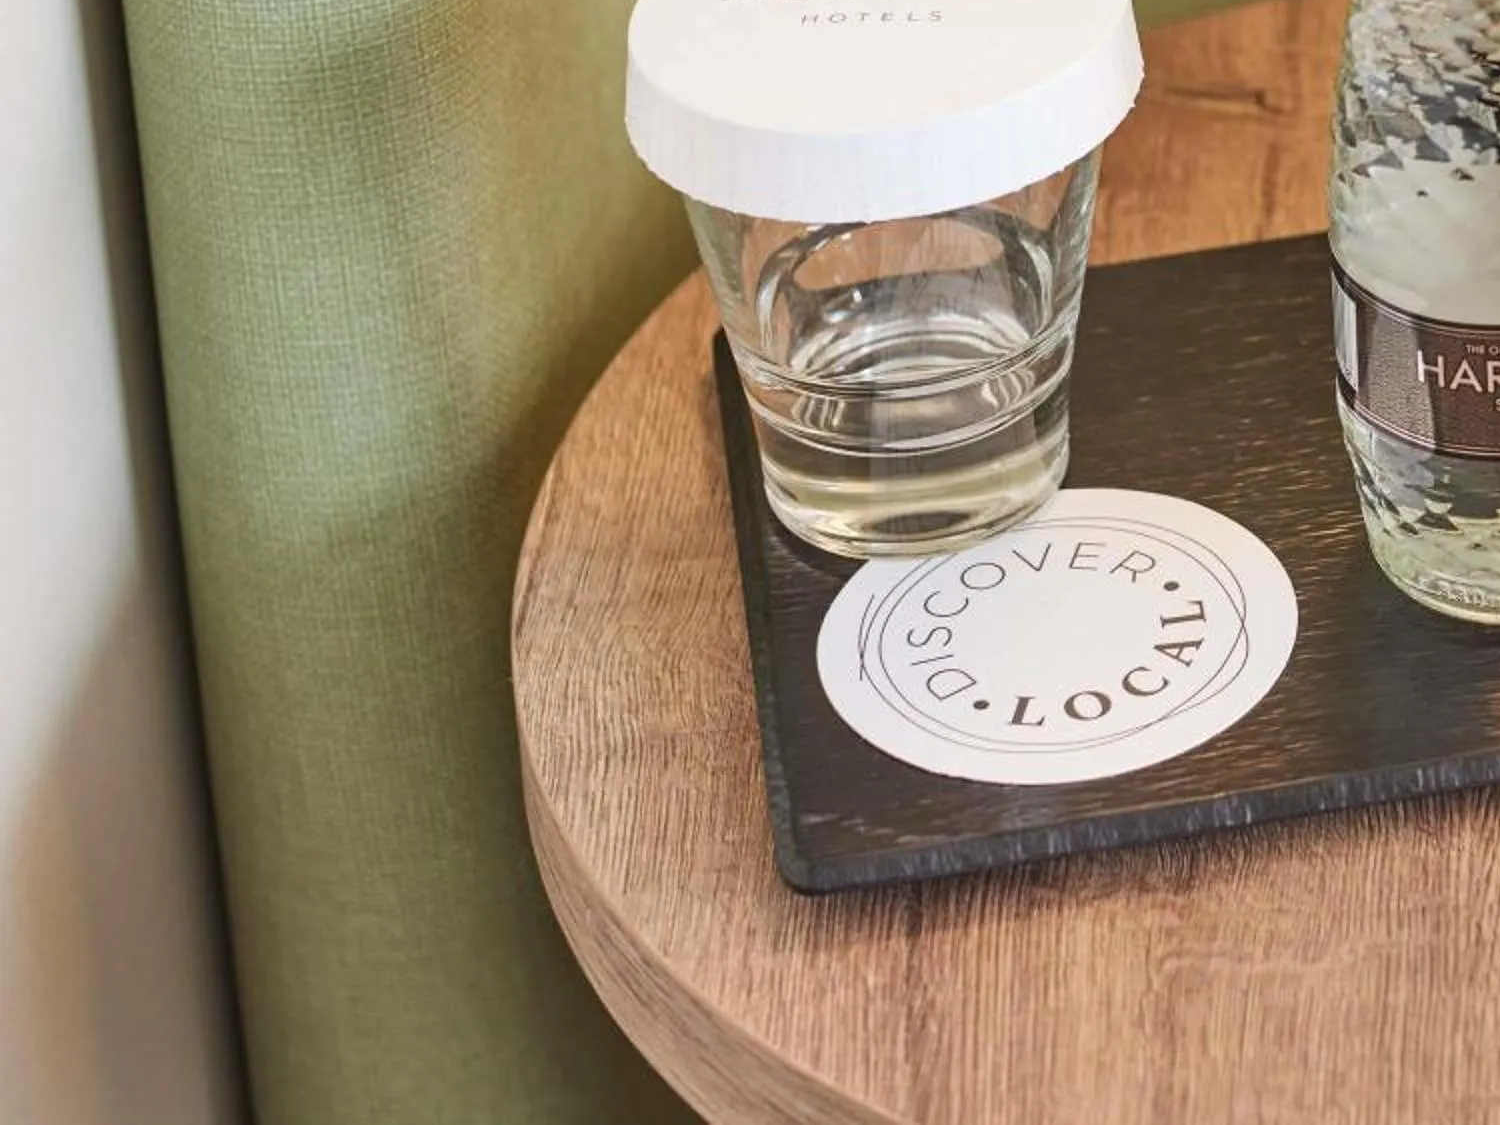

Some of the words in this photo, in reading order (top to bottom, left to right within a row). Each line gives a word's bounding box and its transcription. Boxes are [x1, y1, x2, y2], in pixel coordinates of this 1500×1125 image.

[801, 10, 942, 26] HOTELS
[1465, 343, 1485, 355] THE
[906, 541, 1157, 701] DISCOVER
[1008, 598, 1207, 728] LOCAL
